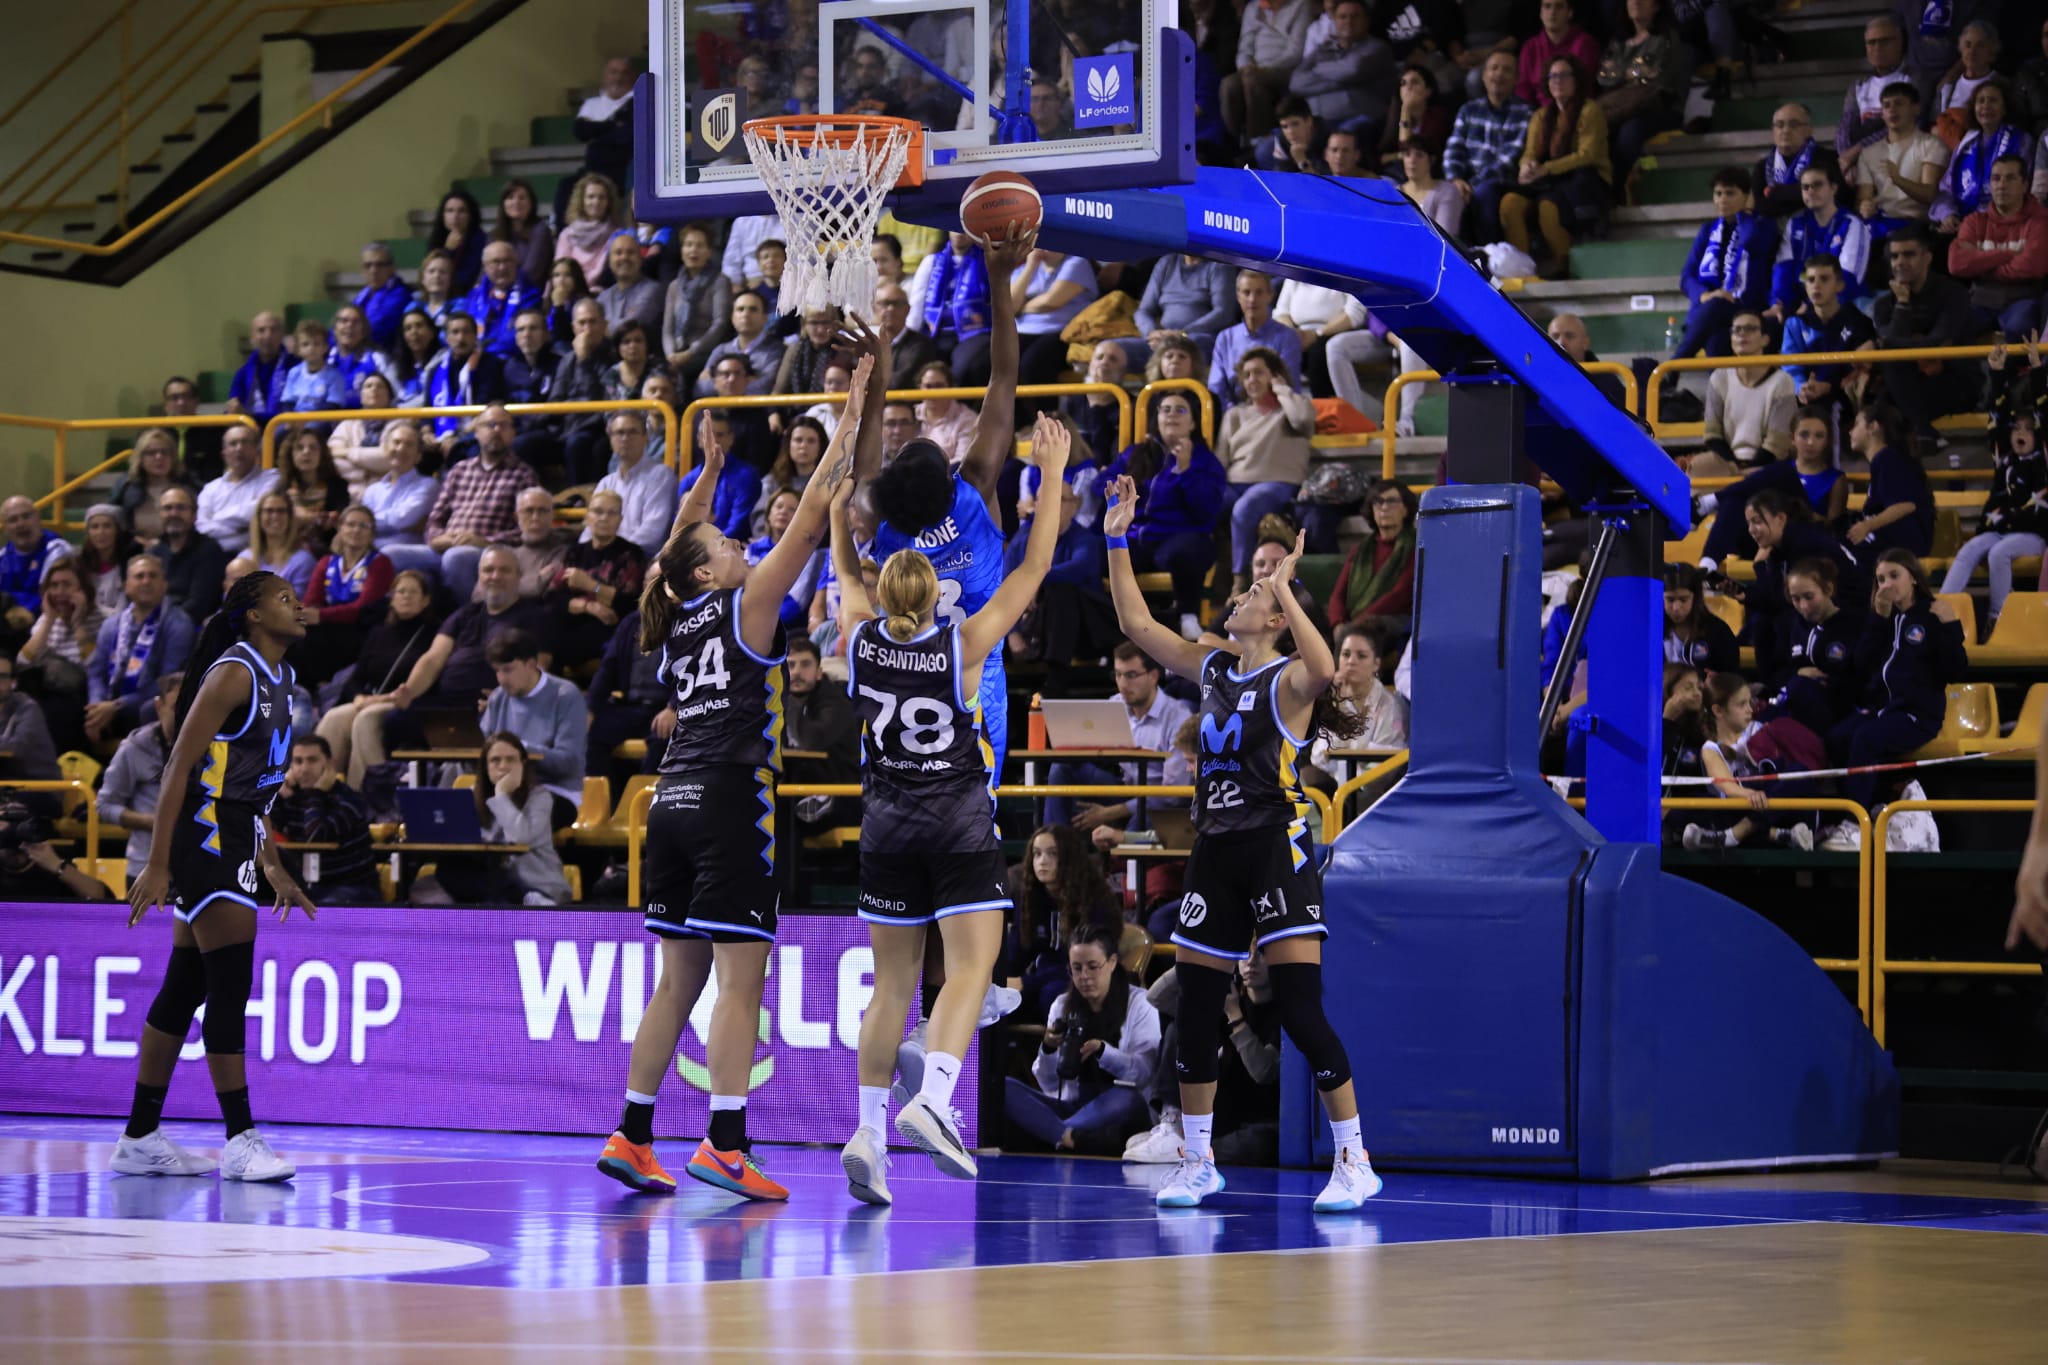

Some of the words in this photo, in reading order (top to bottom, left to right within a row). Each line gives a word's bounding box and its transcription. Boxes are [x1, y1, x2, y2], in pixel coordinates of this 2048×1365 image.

[1080, 108, 1093, 118] LF
[1093, 105, 1129, 117] endesa
[1065, 197, 1113, 220] MONDO
[1204, 209, 1250, 234] MONDO
[914, 516, 960, 549] KONÉ
[671, 636, 731, 702] 34
[858, 639, 878, 662] DE
[877, 647, 948, 673] SANTIAGO
[858, 684, 955, 755] 78
[684, 791, 702, 801] Díaz
[1207, 780, 1245, 809] 22
[862, 893, 906, 911] MADRID
[1181, 892, 1206, 926] hp
[1491, 1127, 1560, 1144] MONDO
